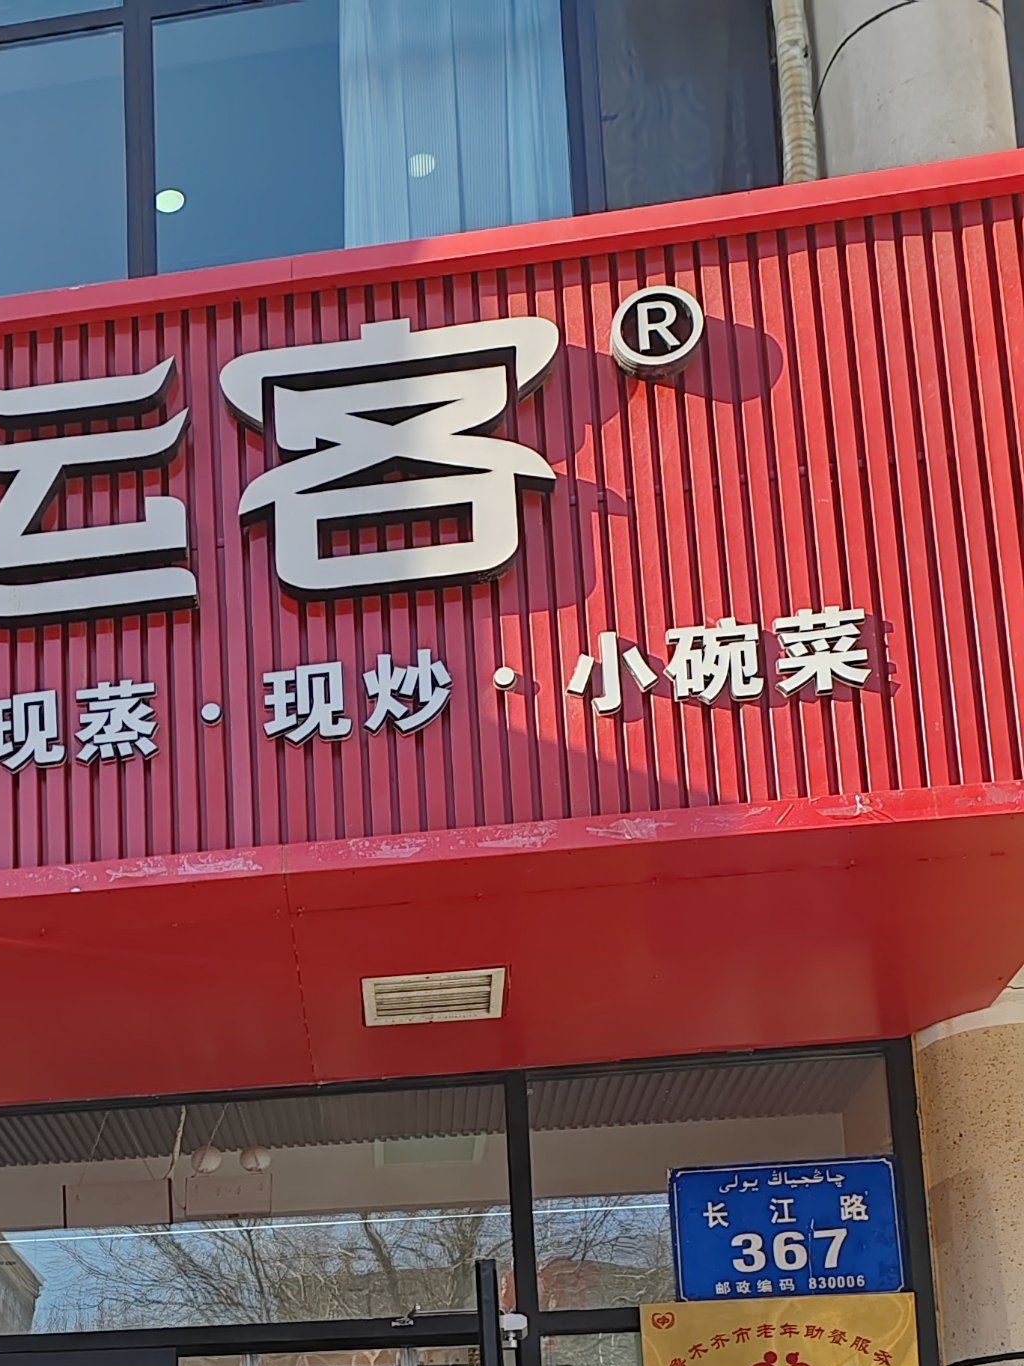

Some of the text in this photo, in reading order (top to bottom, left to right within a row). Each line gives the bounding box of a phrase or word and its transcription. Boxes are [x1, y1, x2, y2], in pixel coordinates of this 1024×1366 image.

[703, 1194, 869, 1228] 长江路
[731, 1228, 847, 1273] 367
[715, 1275, 865, 1295] 邮政编码 830006
